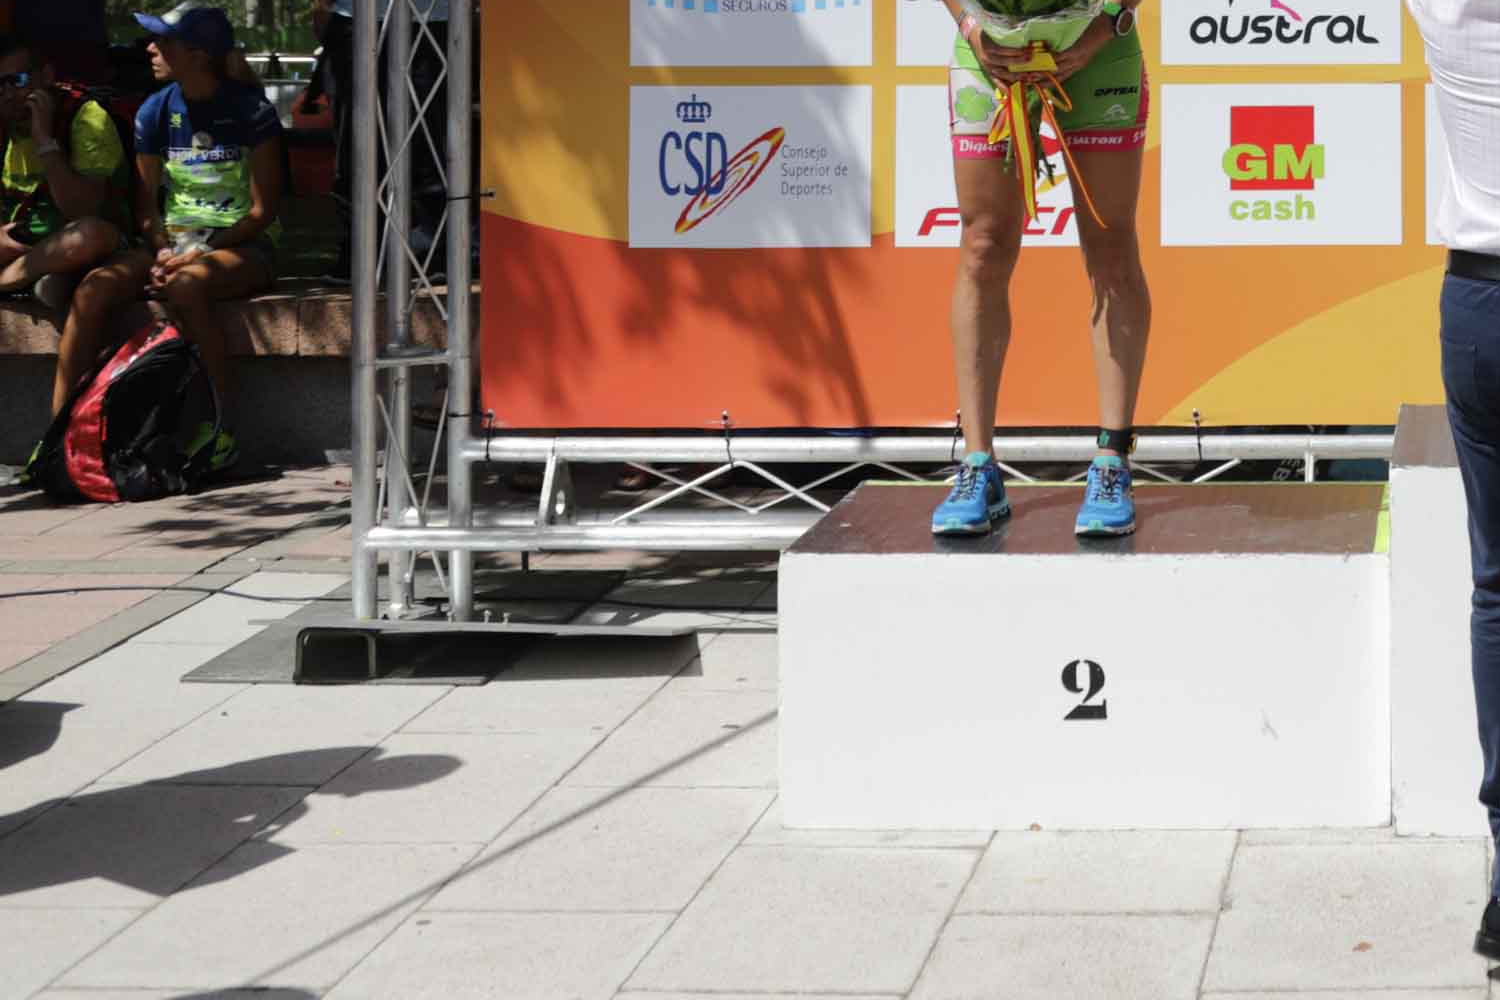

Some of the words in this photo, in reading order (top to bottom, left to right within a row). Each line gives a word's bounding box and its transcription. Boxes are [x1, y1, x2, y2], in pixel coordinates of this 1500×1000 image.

[721, 0, 788, 14] SEGUROS
[659, 130, 728, 197] CSD
[781, 144, 828, 164] Consejo
[1222, 142, 1325, 181] GM
[780, 163, 831, 181] Superior
[834, 163, 849, 178] de
[780, 180, 833, 199] Deportes
[1228, 190, 1316, 221] cash
[1061, 659, 1108, 721] 2
